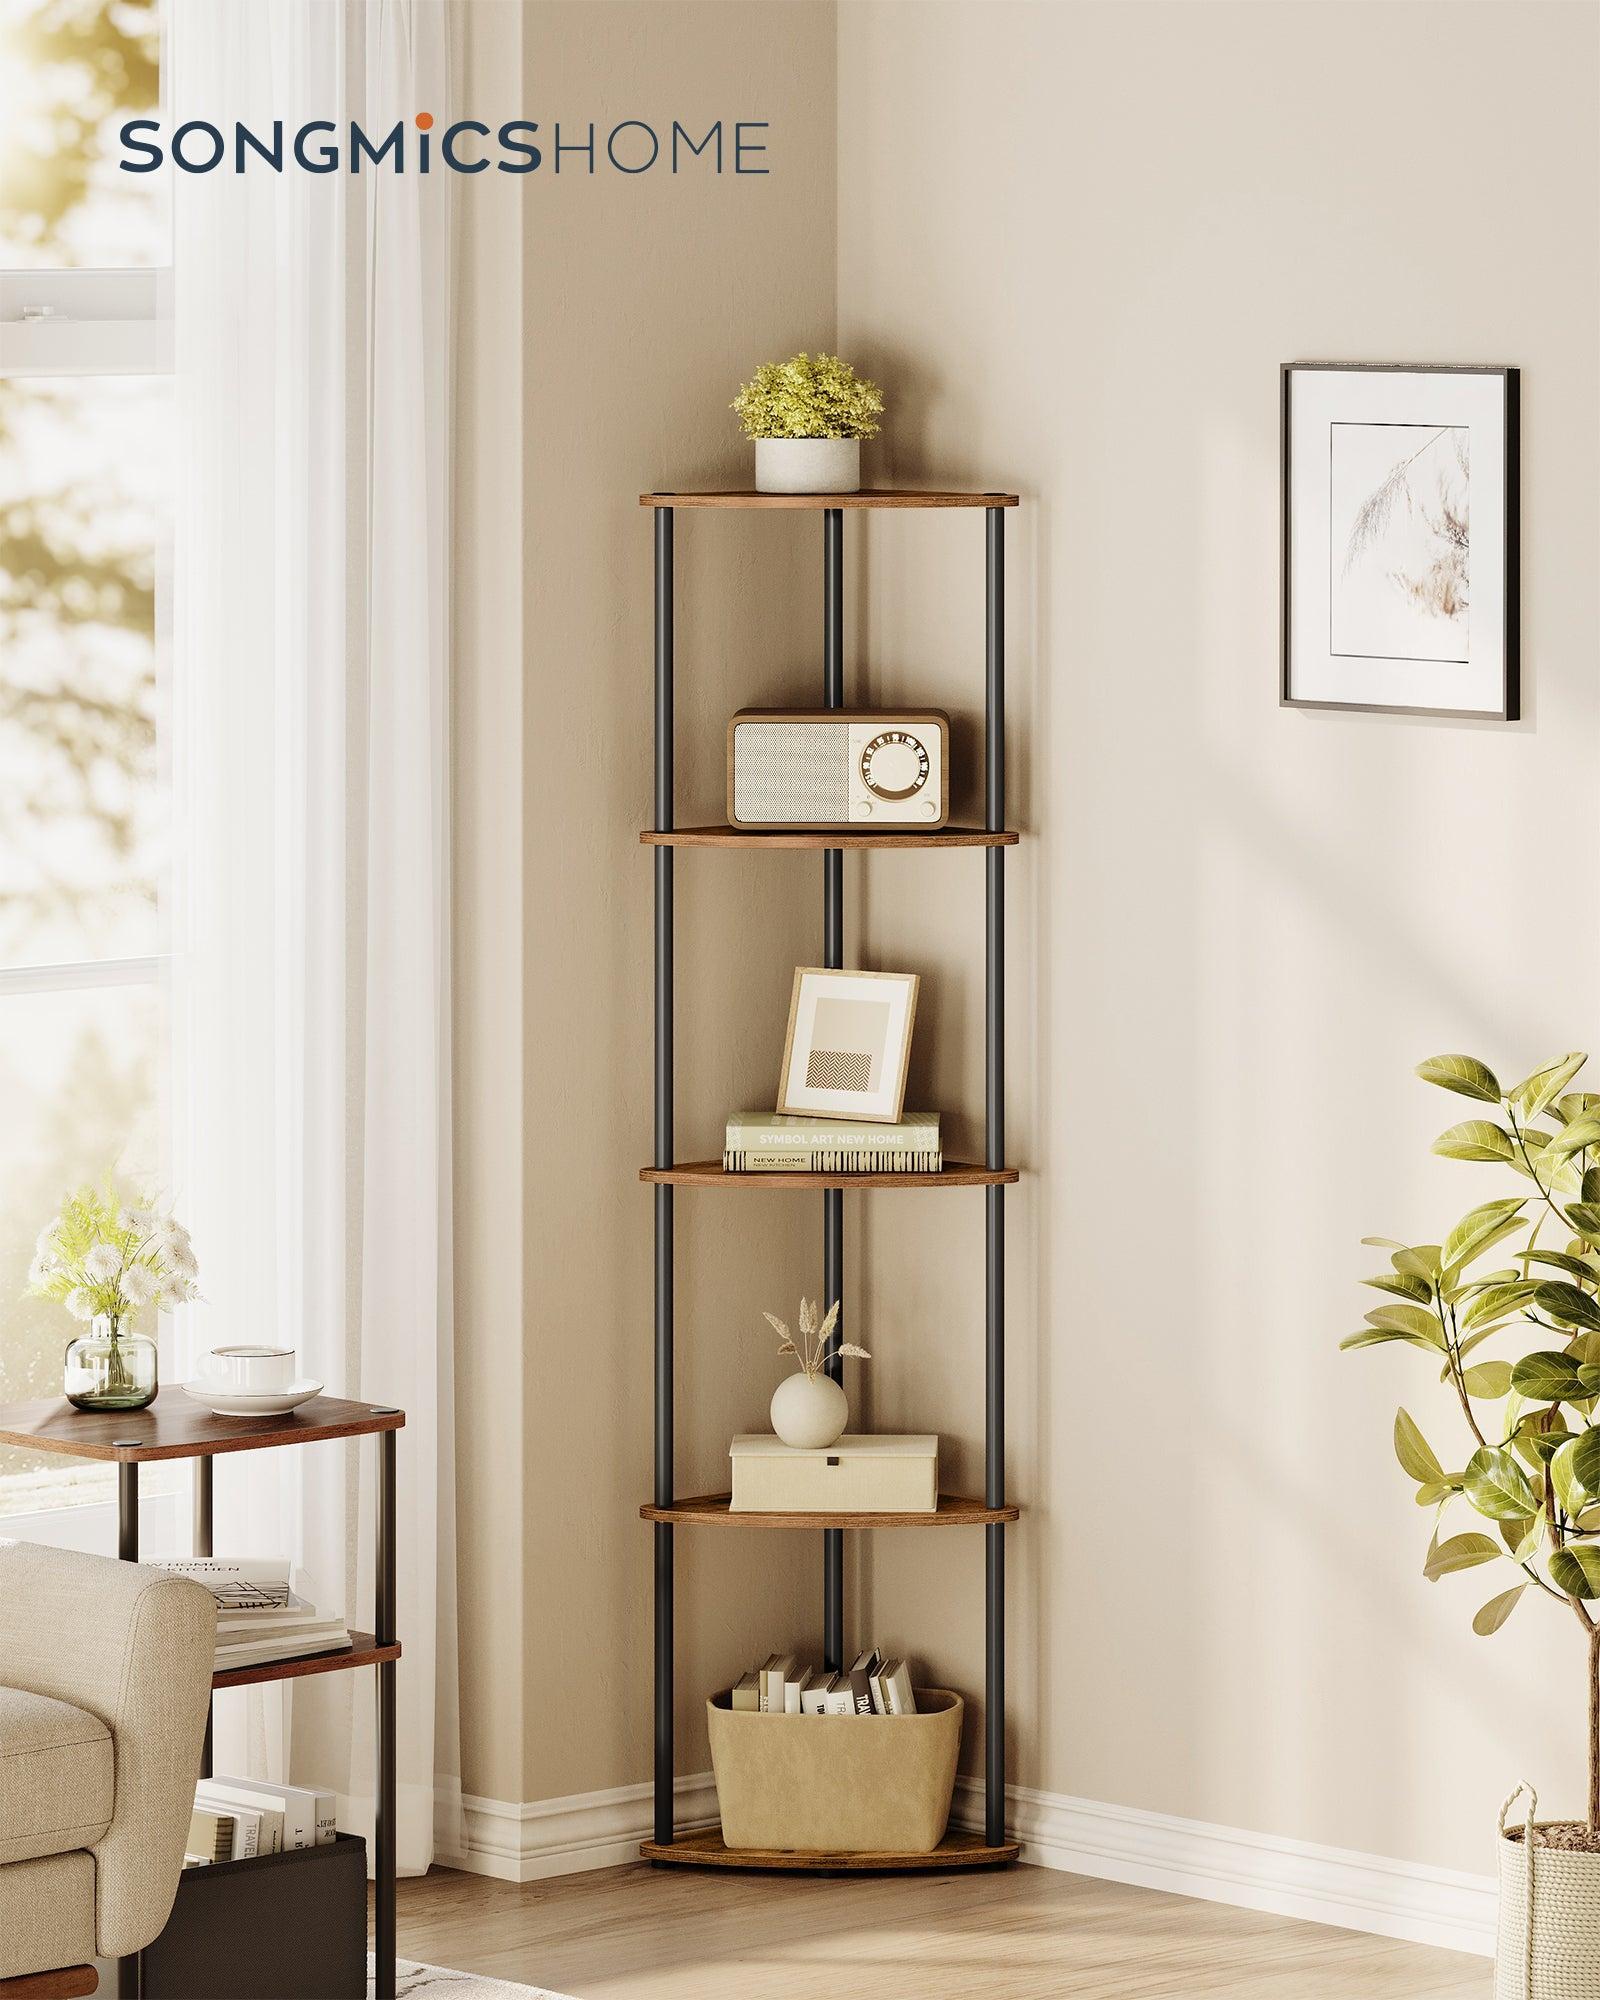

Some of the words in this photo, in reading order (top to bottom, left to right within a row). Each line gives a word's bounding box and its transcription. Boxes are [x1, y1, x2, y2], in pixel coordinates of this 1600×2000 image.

[759, 1134, 808, 1145] SYMBOL
[809, 1134, 833, 1145] ART
[837, 1134, 866, 1145] NEW
[868, 1134, 904, 1145] HOME
[244, 1823, 257, 1858] TRAVEL
